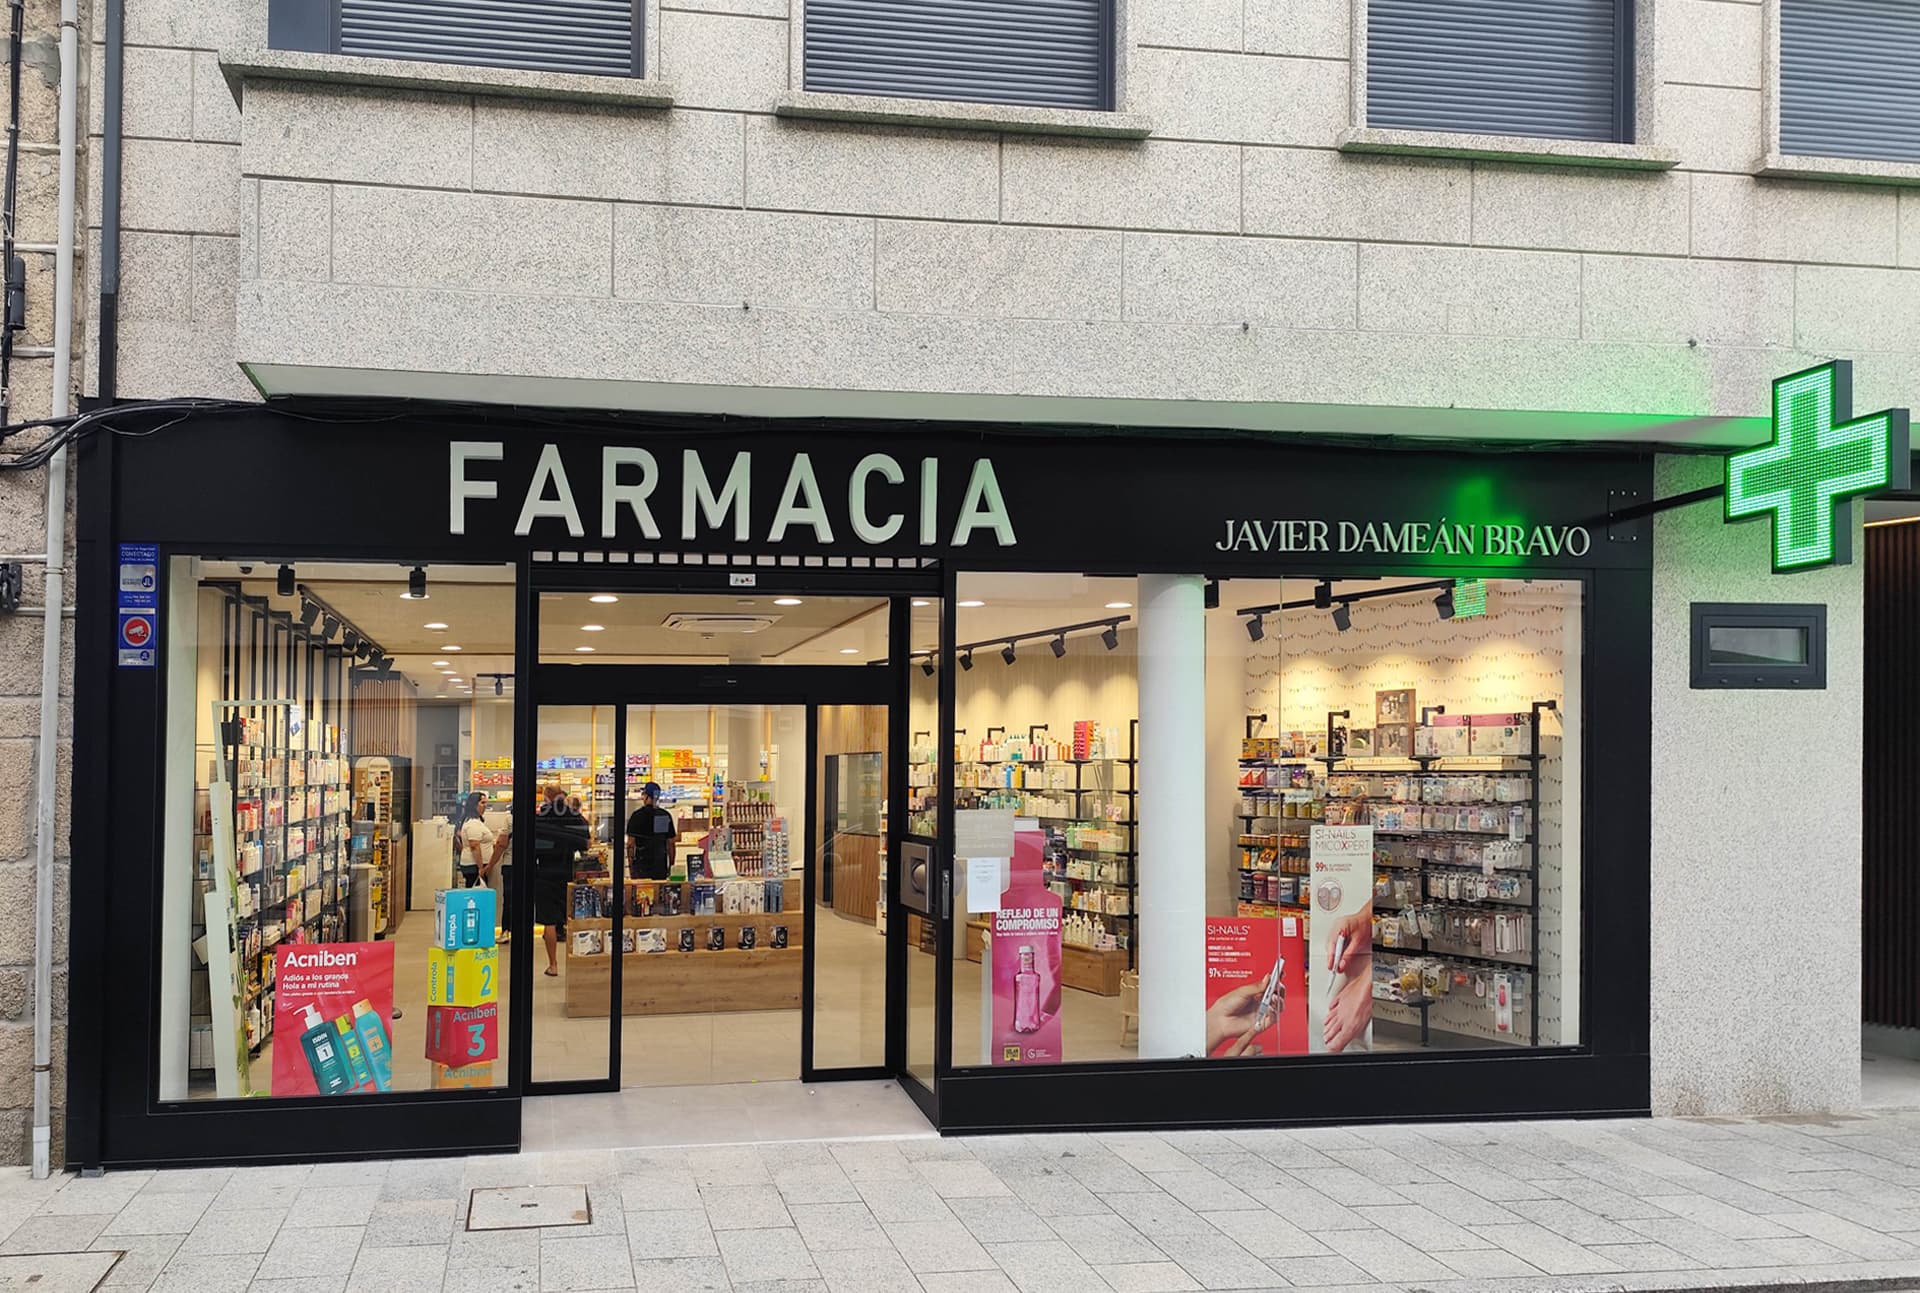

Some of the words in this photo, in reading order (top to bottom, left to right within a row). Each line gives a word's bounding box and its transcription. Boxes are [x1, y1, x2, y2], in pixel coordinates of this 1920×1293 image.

[449, 441, 1017, 546] FARMACIA
[1215, 519, 1330, 552] JAVIER
[1338, 516, 1475, 555] DAMEÁN
[1483, 523, 1591, 557] BRAVO
[1315, 840, 1370, 851] MICOXPERT
[1034, 908, 1045, 918] DE
[1046, 907, 1058, 918] UN
[448, 913, 457, 947] Limpia
[996, 918, 1059, 931] COMPROMISO
[1207, 924, 1250, 935] SI-NAILS
[283, 950, 358, 969] Acniben
[283, 974, 305, 983] Adiós
[312, 973, 323, 981] los
[430, 960, 438, 1002] Controla
[480, 964, 492, 997] 2
[1208, 967, 1221, 978] 97%
[282, 982, 300, 991] Hola
[318, 981, 340, 989] rutina
[452, 1006, 497, 1024] Acniben
[466, 1023, 486, 1057] 3
